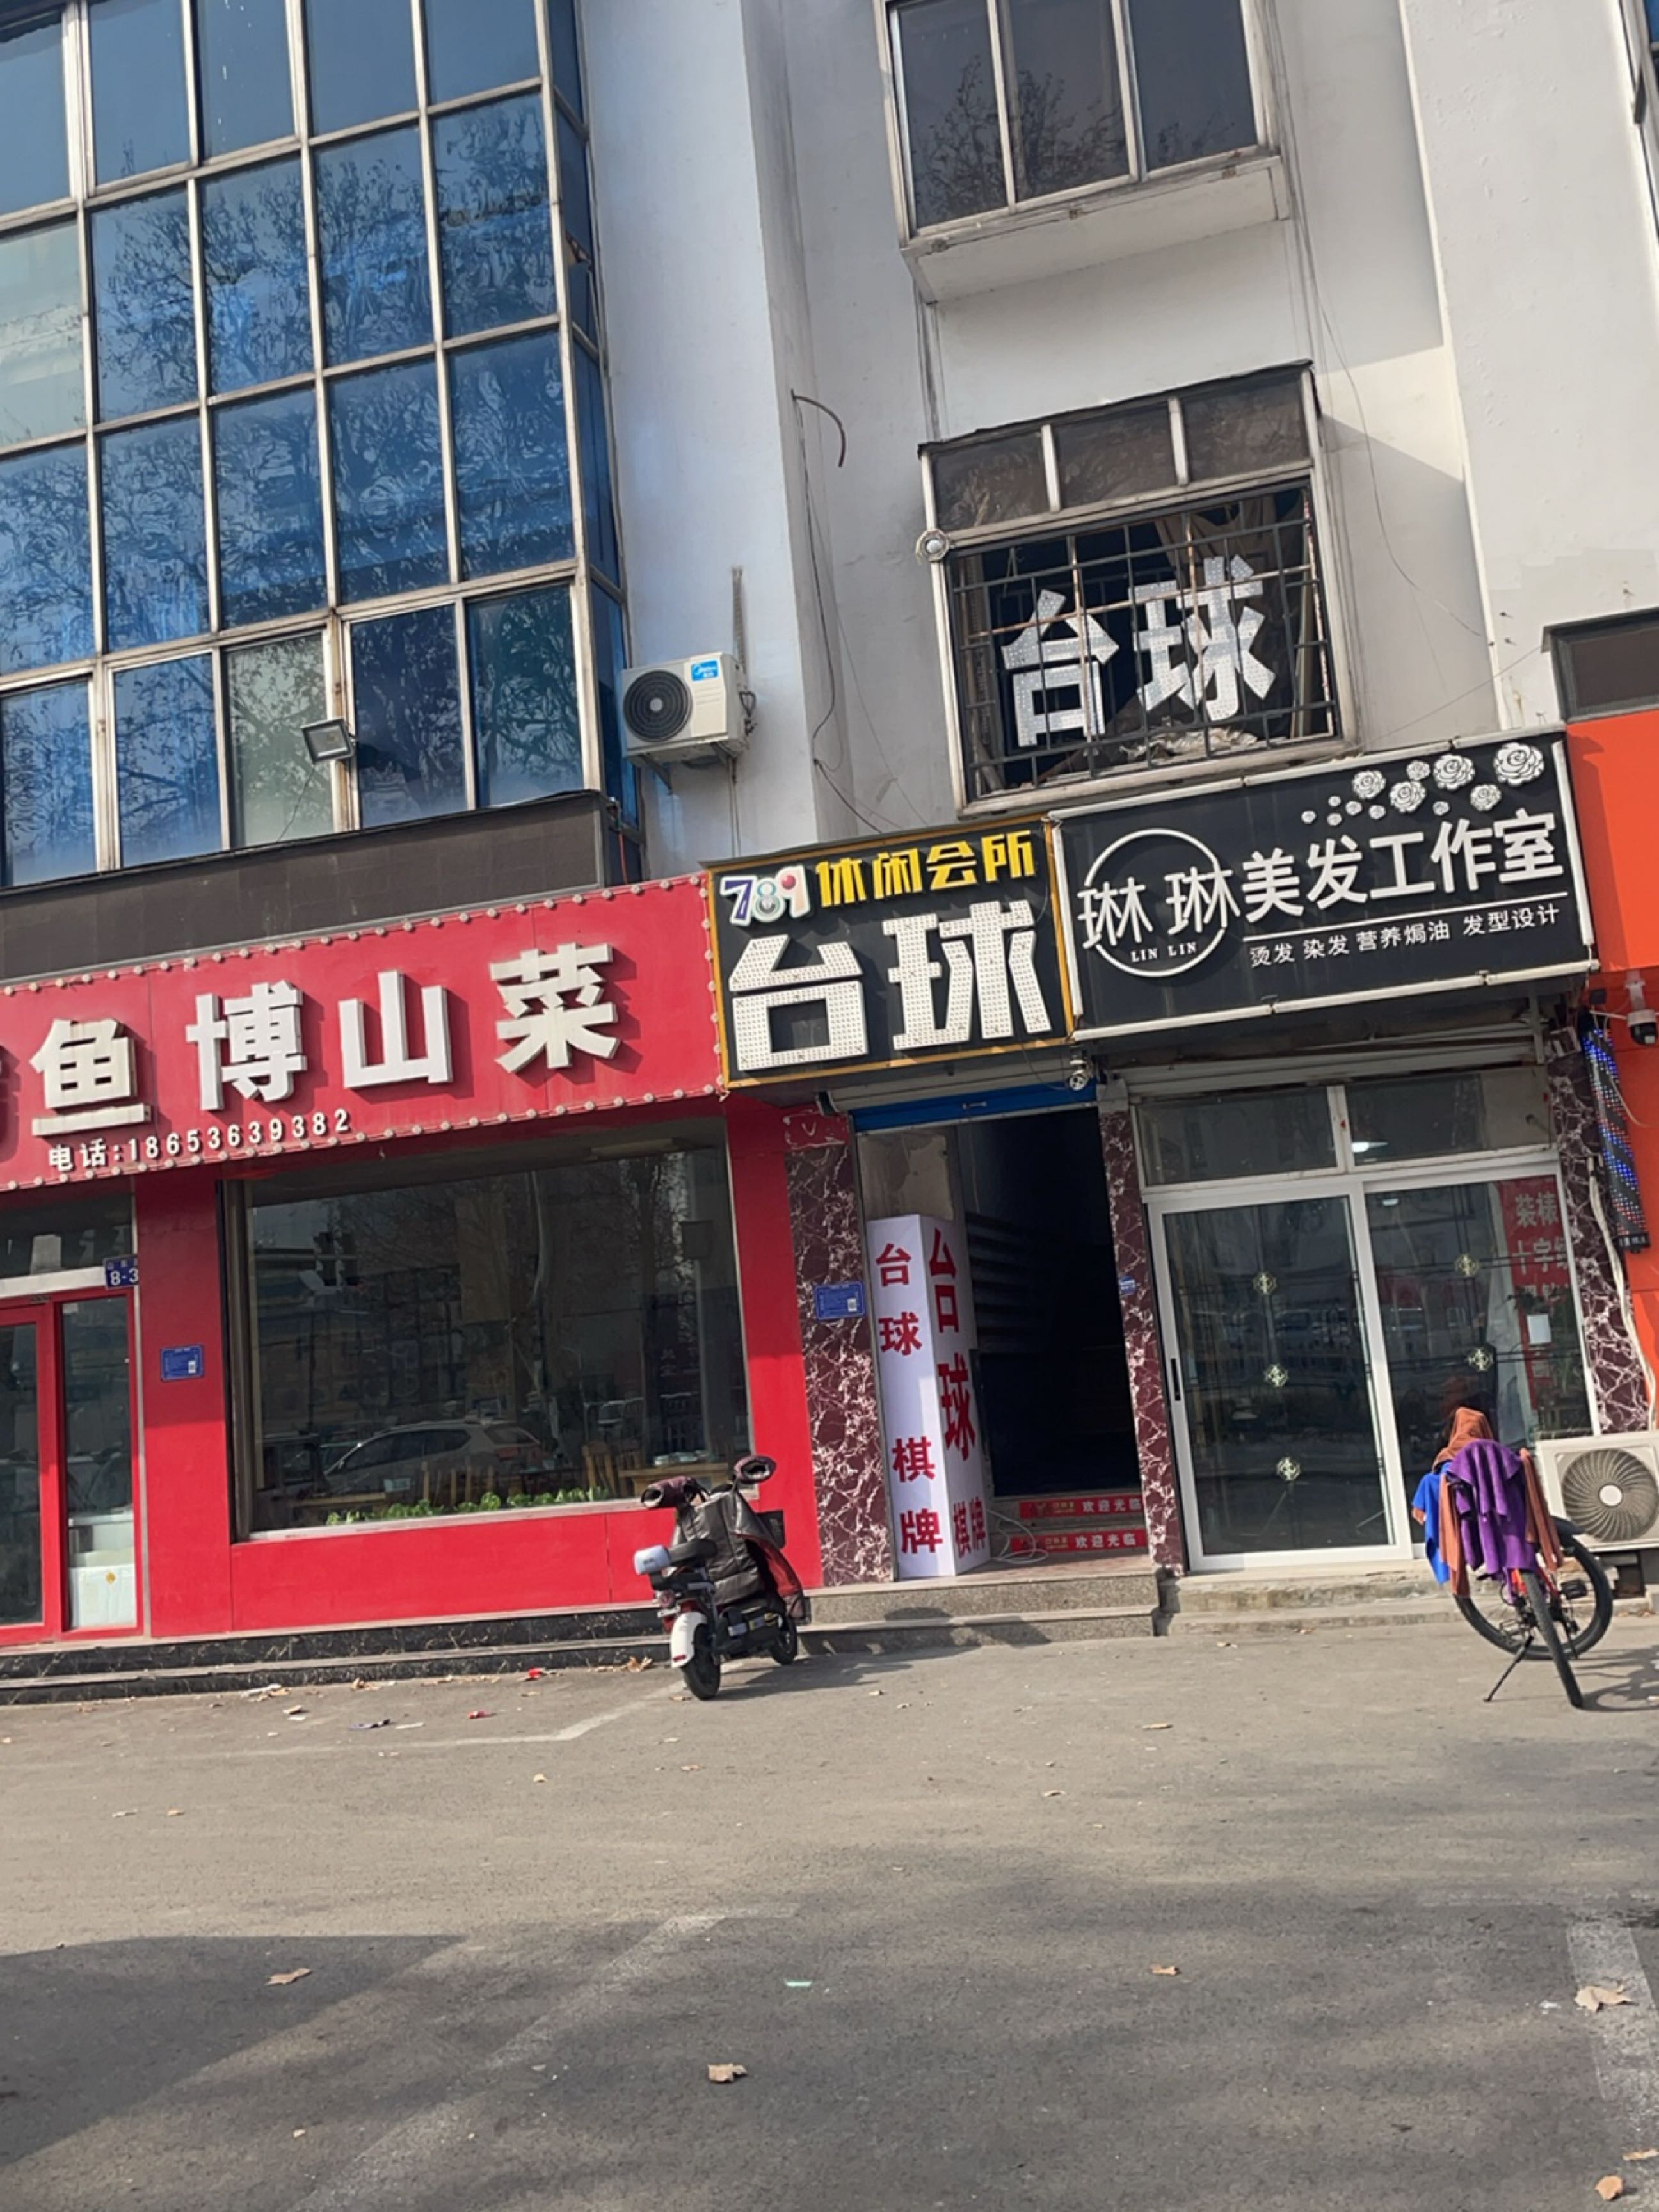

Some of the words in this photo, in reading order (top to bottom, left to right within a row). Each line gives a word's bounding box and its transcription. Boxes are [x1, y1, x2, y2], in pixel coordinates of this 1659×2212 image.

[1002, 556, 1276, 748] 台球
[720, 865, 810, 926] 789
[816, 830, 1036, 908] 休闲会所
[1242, 808, 1564, 923] 美发工作室
[728, 899, 1052, 1071] 台球
[1130, 949, 1158, 963] LIN
[1167, 942, 1198, 956] LIN
[1249, 943, 1295, 968] 烫发
[1303, 935, 1350, 959] 染发
[1356, 920, 1450, 952] 营养焗油
[1463, 903, 1560, 936] 发型设计
[29, 943, 621, 1136] 鱼博山菜
[49, 1108, 350, 1171] 电话:18653639382
[876, 1244, 922, 1356] 台球
[929, 1228, 975, 1462] 台球
[892, 1436, 943, 1554] 棋牌
[1075, 1533, 1136, 1549] 欢迎光临
[1082, 1498, 1142, 1512] 欢迎光临
